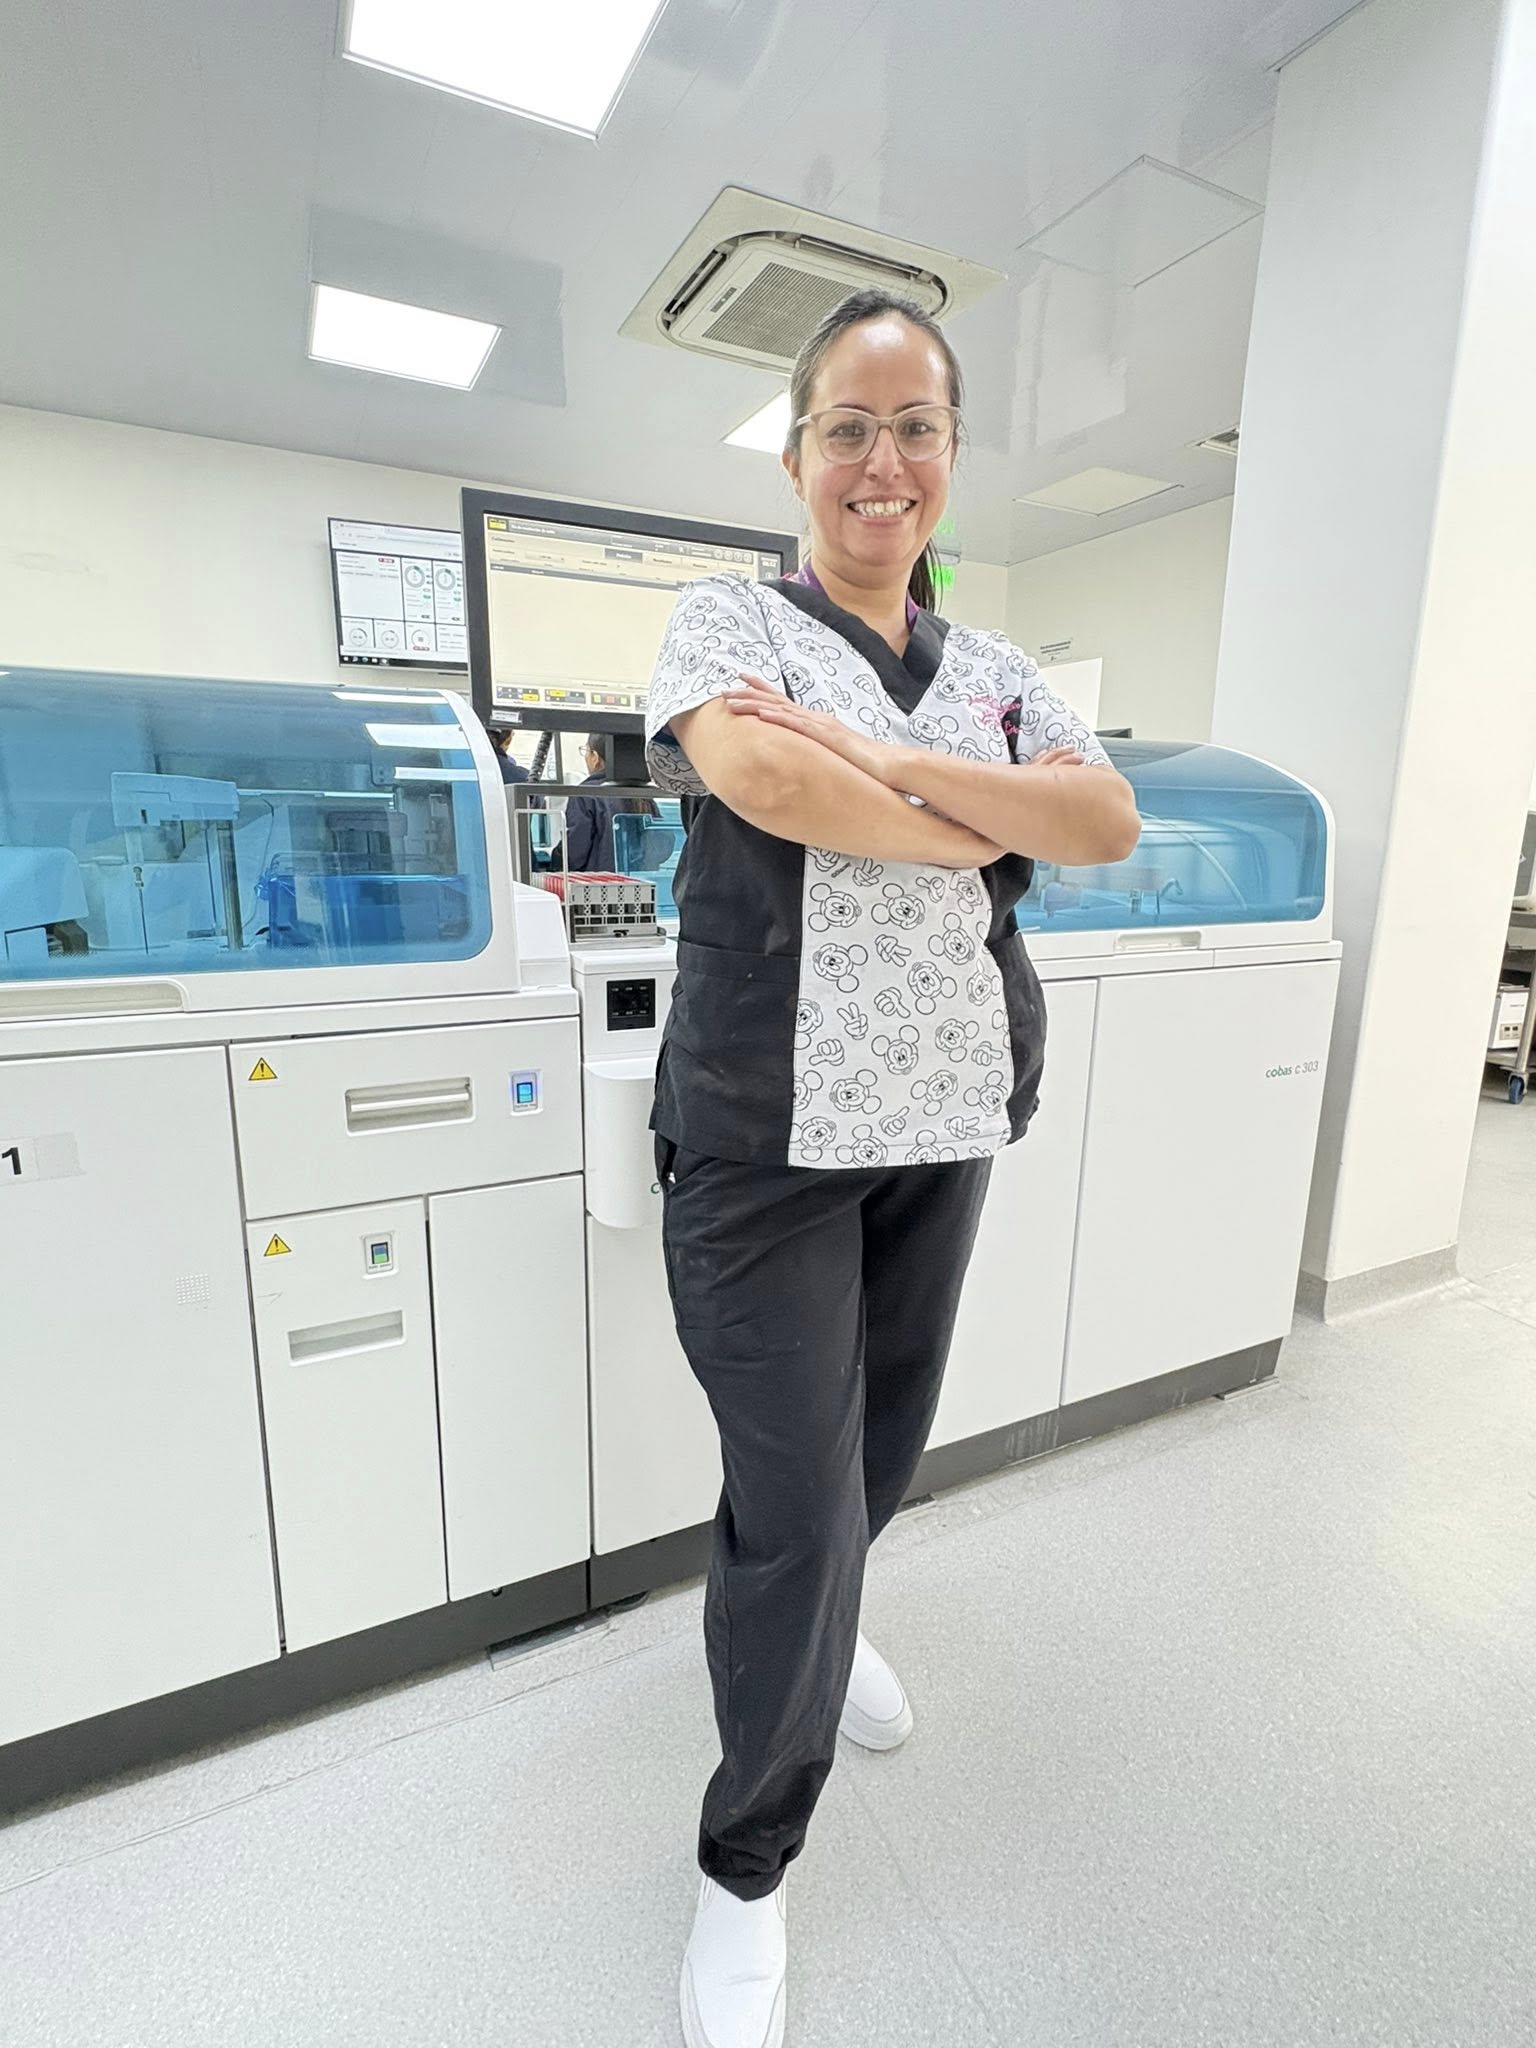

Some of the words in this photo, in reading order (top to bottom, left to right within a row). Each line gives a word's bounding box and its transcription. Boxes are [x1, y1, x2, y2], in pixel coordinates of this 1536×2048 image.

[1265, 1065, 1293, 1078] cobas
[1294, 1065, 1302, 1075] c
[1302, 1060, 1319, 1074] 303
[1, 1146, 22, 1176] 1
